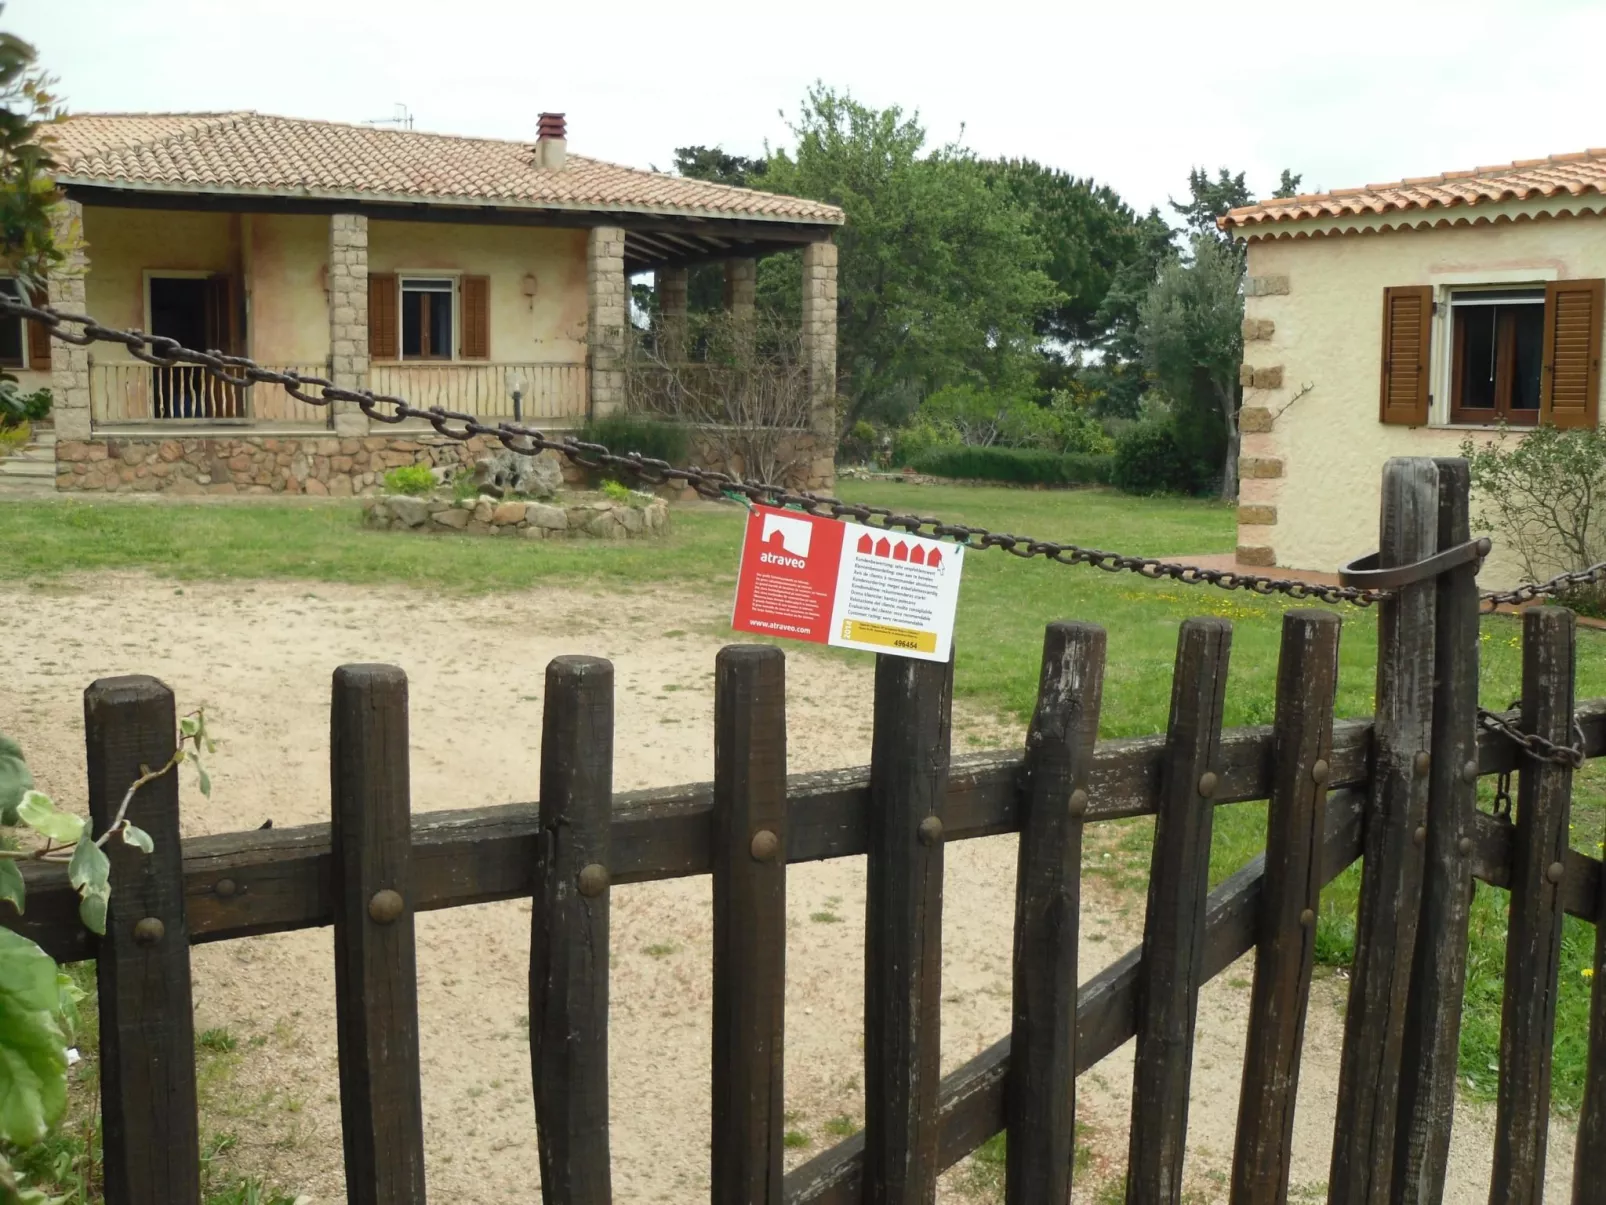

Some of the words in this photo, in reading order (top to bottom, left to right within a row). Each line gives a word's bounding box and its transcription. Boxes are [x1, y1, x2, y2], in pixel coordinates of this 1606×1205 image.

[760, 551, 806, 569] atraveo
[749, 619, 811, 635] www.atraveo.com
[844, 620, 852, 639] 2014
[894, 639, 917, 649] 496454
